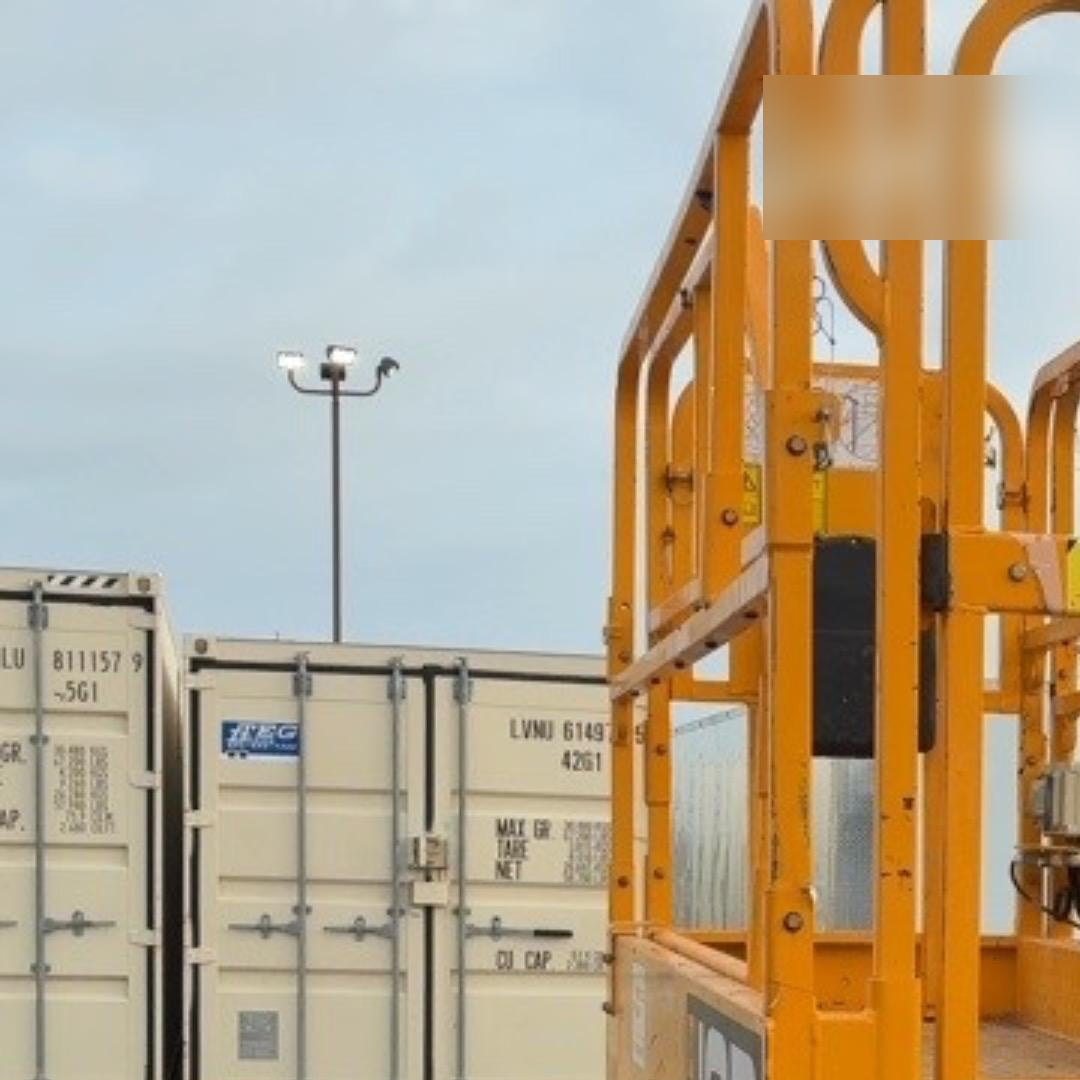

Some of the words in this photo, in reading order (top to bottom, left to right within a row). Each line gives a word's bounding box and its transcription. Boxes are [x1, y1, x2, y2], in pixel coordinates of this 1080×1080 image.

[53, 651, 121, 672] 811157
[132, 653, 144, 672] 9
[54, 681, 98, 702] 5G1
[509, 718, 554, 741] LVNU
[561, 750, 601, 771] 42G1
[495, 818, 526, 838] MAX
[496, 839, 529, 860] TARE
[495, 860, 523, 880] NET
